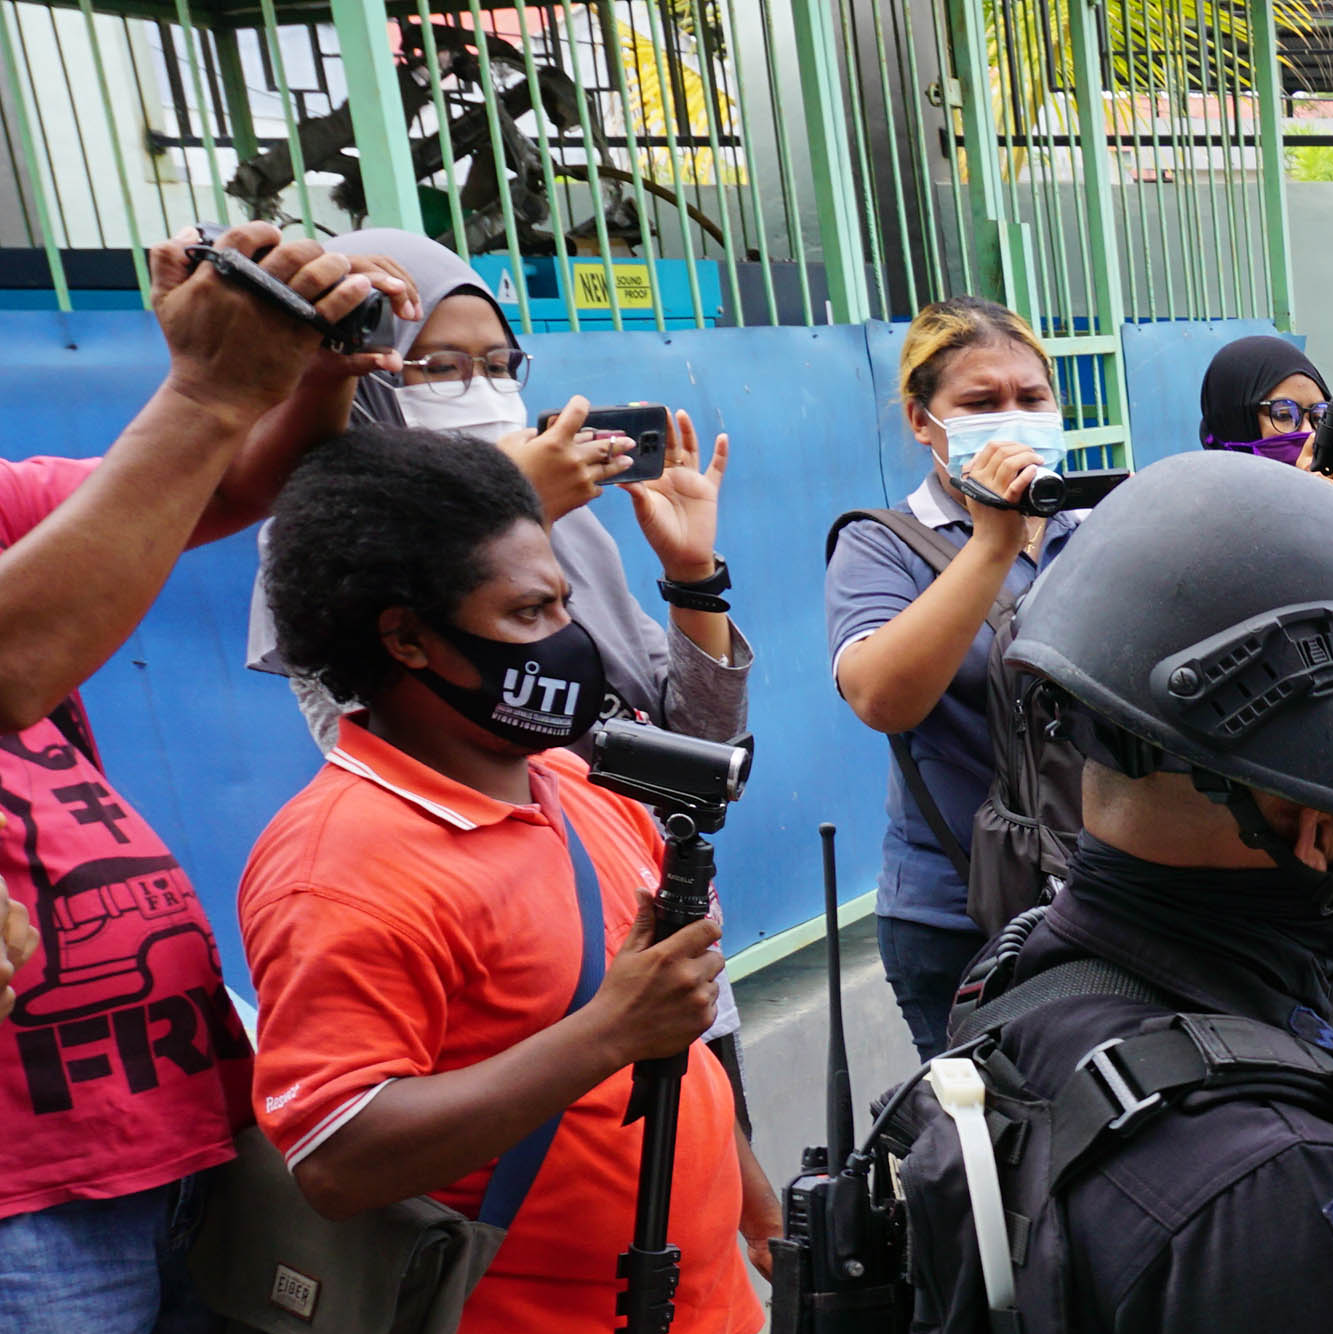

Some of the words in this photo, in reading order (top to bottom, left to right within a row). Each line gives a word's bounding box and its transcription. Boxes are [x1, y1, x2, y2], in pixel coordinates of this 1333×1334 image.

[578, 272, 609, 304] NEW
[616, 275, 643, 287] SOUND
[624, 288, 648, 300] PROOF
[490, 711, 519, 727] VIDEO
[519, 718, 572, 737] JOURNALIST
